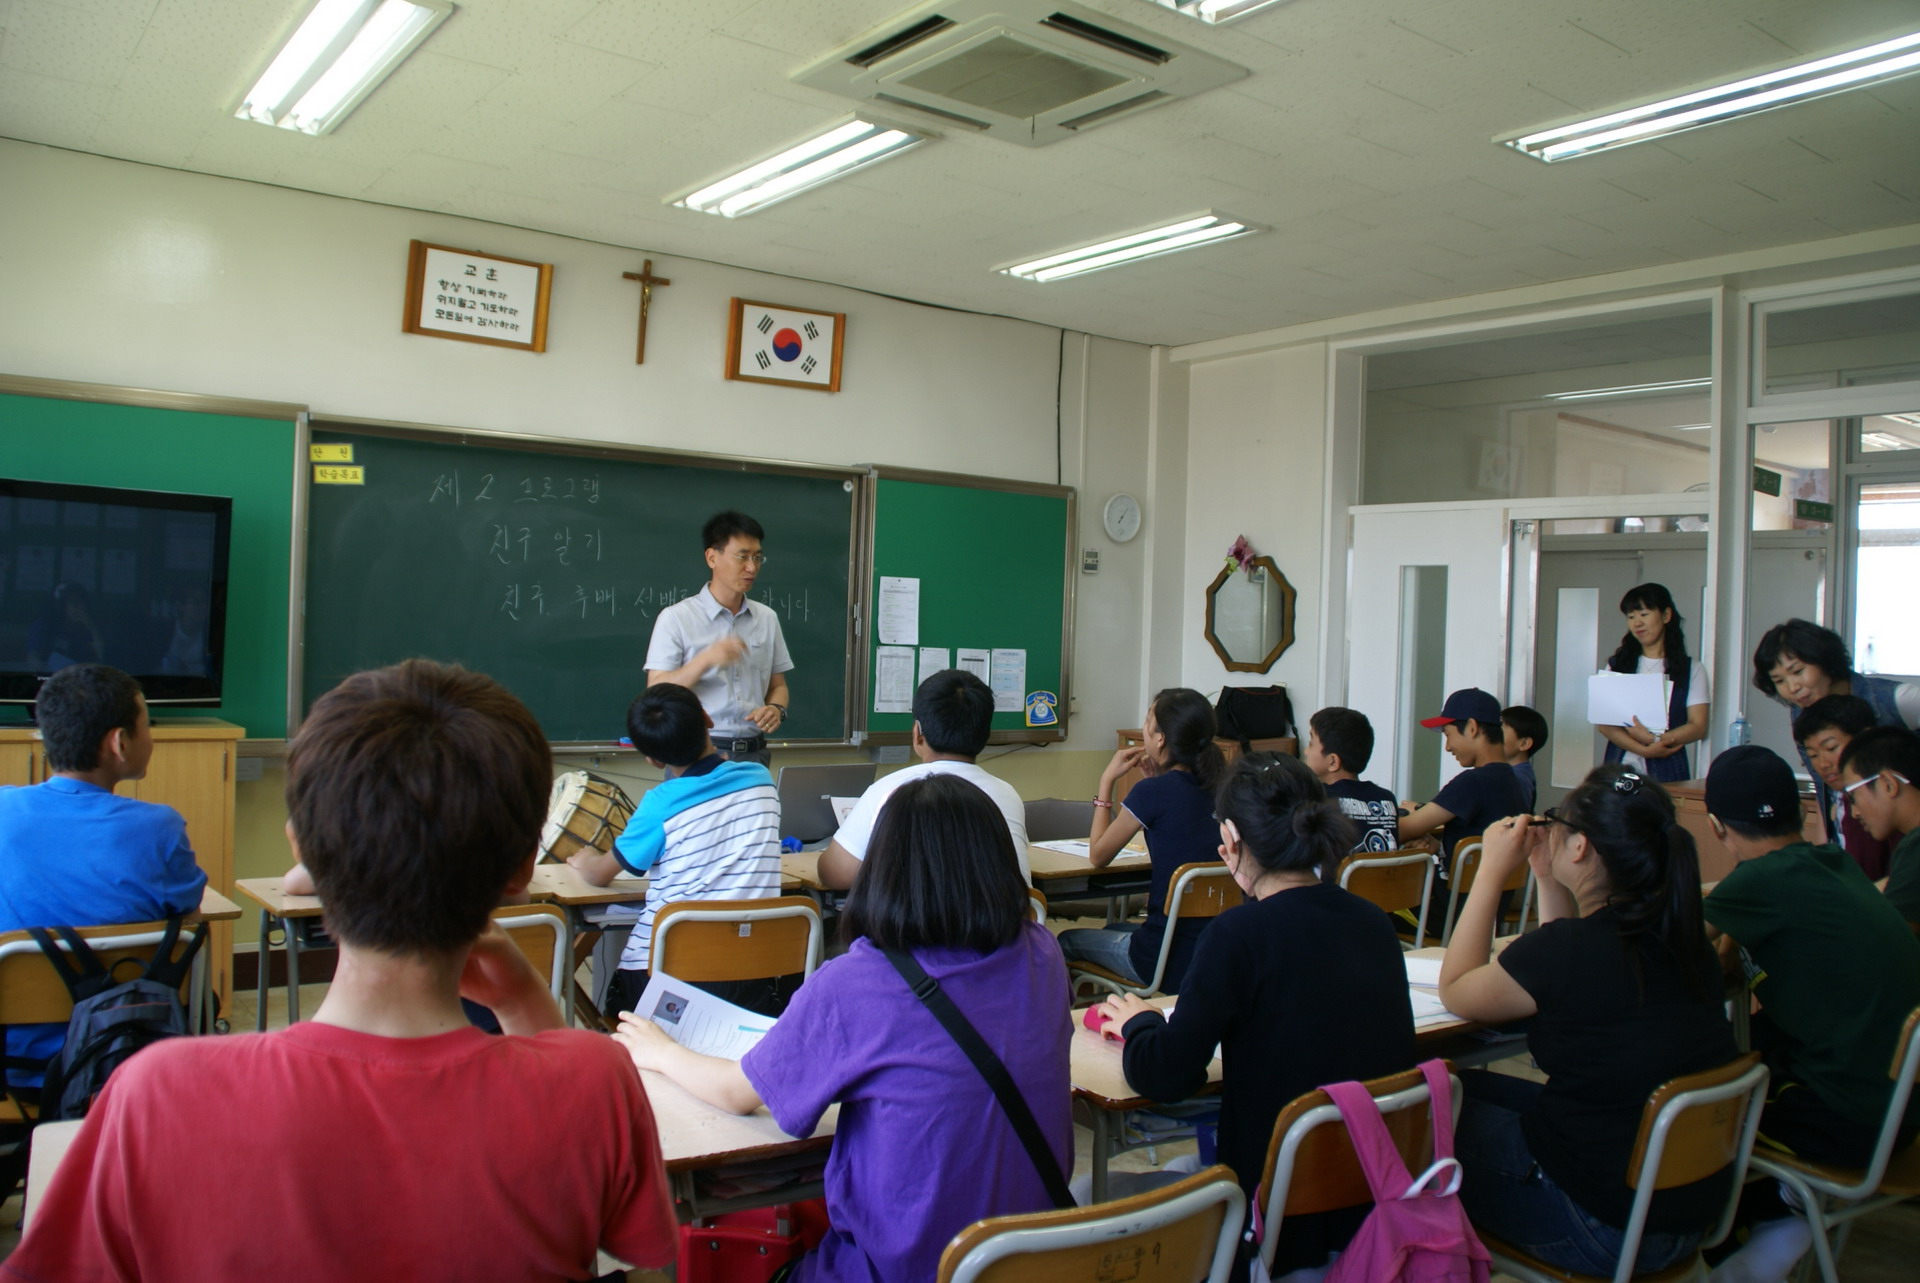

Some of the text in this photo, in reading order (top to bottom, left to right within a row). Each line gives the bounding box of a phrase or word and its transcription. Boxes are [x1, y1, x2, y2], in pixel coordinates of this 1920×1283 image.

[438, 279, 462, 293] 항상
[479, 302, 519, 316] 기도하라
[477, 316, 520, 331] 감사하라
[318, 468, 359, 480] 학습목표
[428, 469, 602, 510] 제 2 프로그램
[489, 523, 532, 564] 친구
